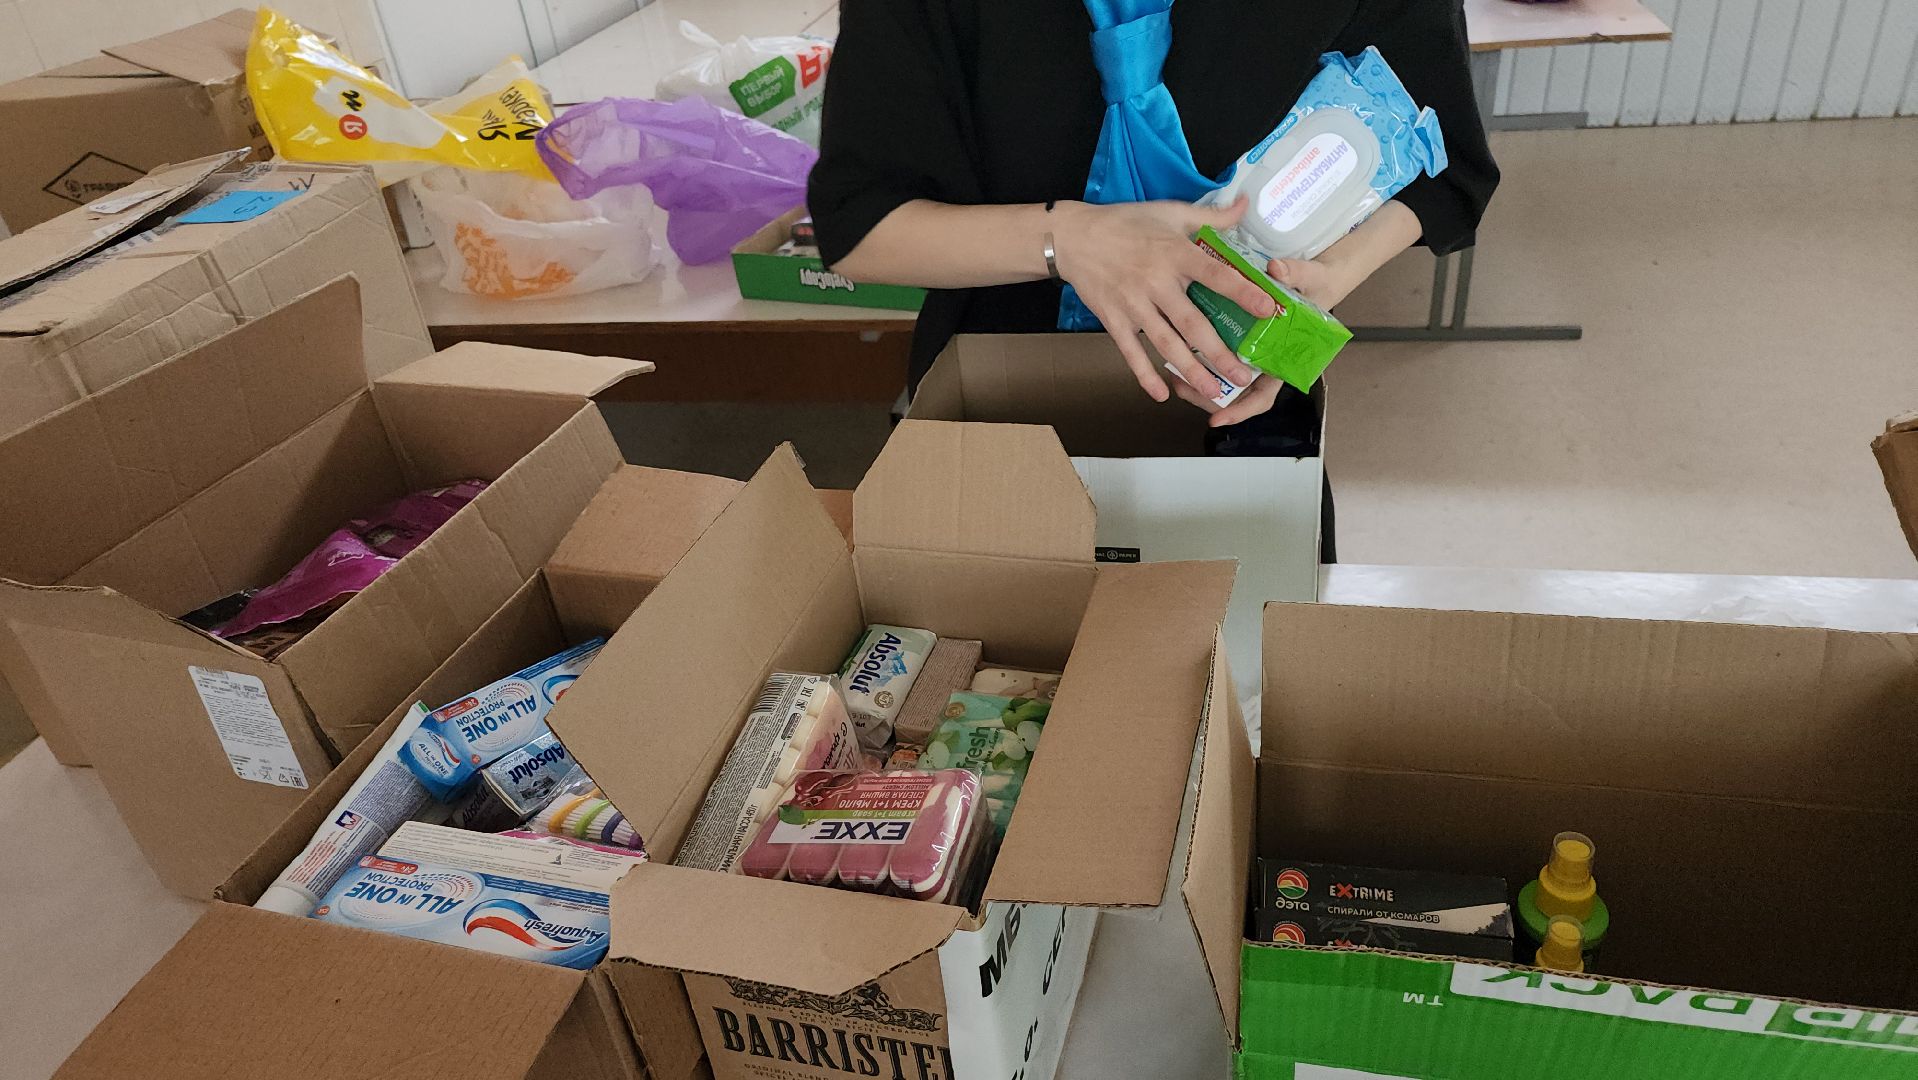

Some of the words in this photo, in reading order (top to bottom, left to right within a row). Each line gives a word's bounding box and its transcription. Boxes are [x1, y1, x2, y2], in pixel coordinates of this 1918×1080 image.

[740, 65, 785, 95] ПЕРВЫЙ
[1216, 309, 1247, 338] Absolut
[849, 632, 902, 694] Absolut
[456, 699, 505, 727] PROTECTION
[508, 694, 538, 718] ALL
[499, 712, 512, 725] IN
[461, 717, 499, 743] ONE
[956, 726, 991, 769] fresh
[418, 743, 431, 757] ALL
[434, 761, 449, 776] ONE
[508, 743, 566, 784] Absolut
[839, 799, 872, 809] МЫЛО
[860, 791, 889, 799] ВИШНЯ
[872, 799, 889, 809] 1+1
[891, 799, 922, 809] КРЕМ
[892, 791, 925, 799] СПЕЛАЯ
[814, 821, 911, 840] EXXE
[344, 881, 400, 903] ONE
[363, 871, 434, 892] PROTECTION
[397, 893, 417, 906] IN
[413, 892, 465, 915] ALL
[1329, 884, 1394, 902] EXTRIME
[1275, 897, 1310, 912] дэта
[1327, 905, 1374, 918] СПИРАЛИ
[1375, 910, 1389, 919] ОТ
[1390, 911, 1440, 924] КОМАРОВ
[523, 917, 607, 947] Aquafresh
[1402, 990, 1444, 1006] TM
[1482, 969, 1755, 1015] PACK
